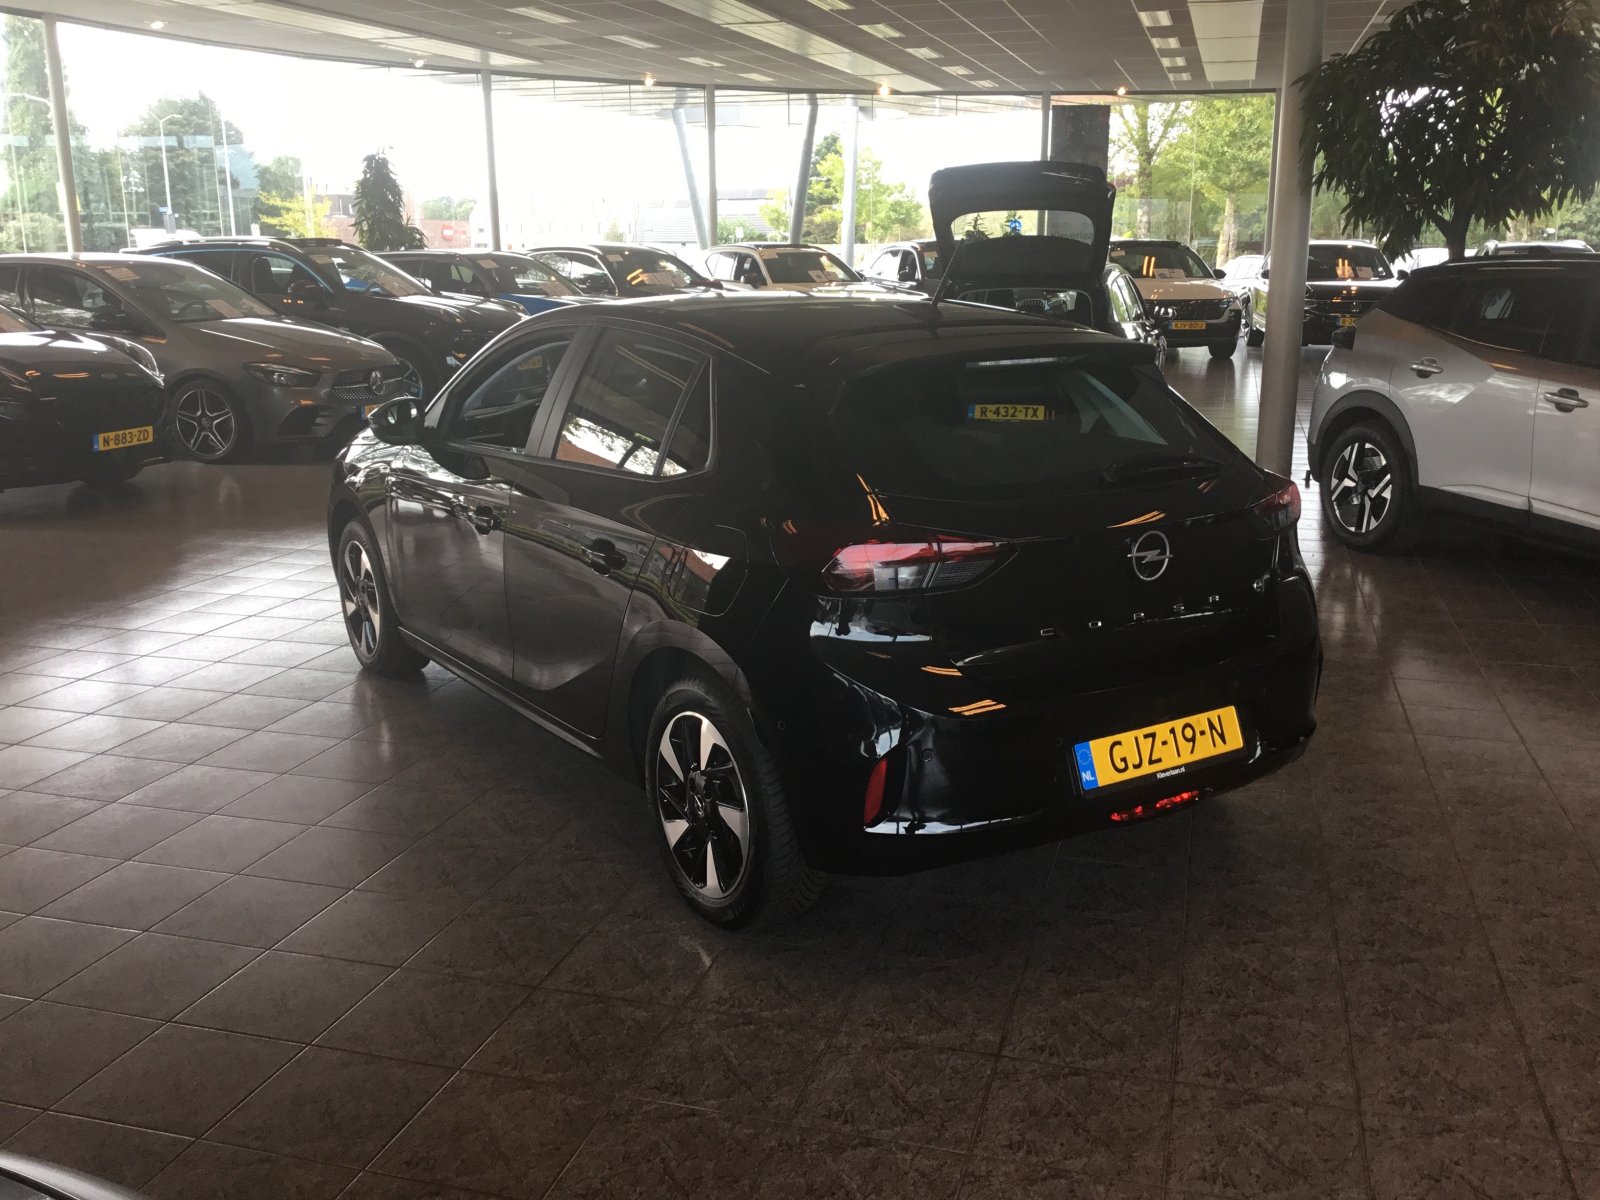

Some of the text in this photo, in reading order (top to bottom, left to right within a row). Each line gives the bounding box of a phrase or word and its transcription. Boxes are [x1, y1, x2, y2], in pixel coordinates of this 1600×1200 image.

[980, 406, 1039, 418] R-432-TX
[103, 428, 150, 447] N-883-ZD
[1108, 714, 1227, 774] GJZ-19-N
[1081, 770, 1095, 782] NL
